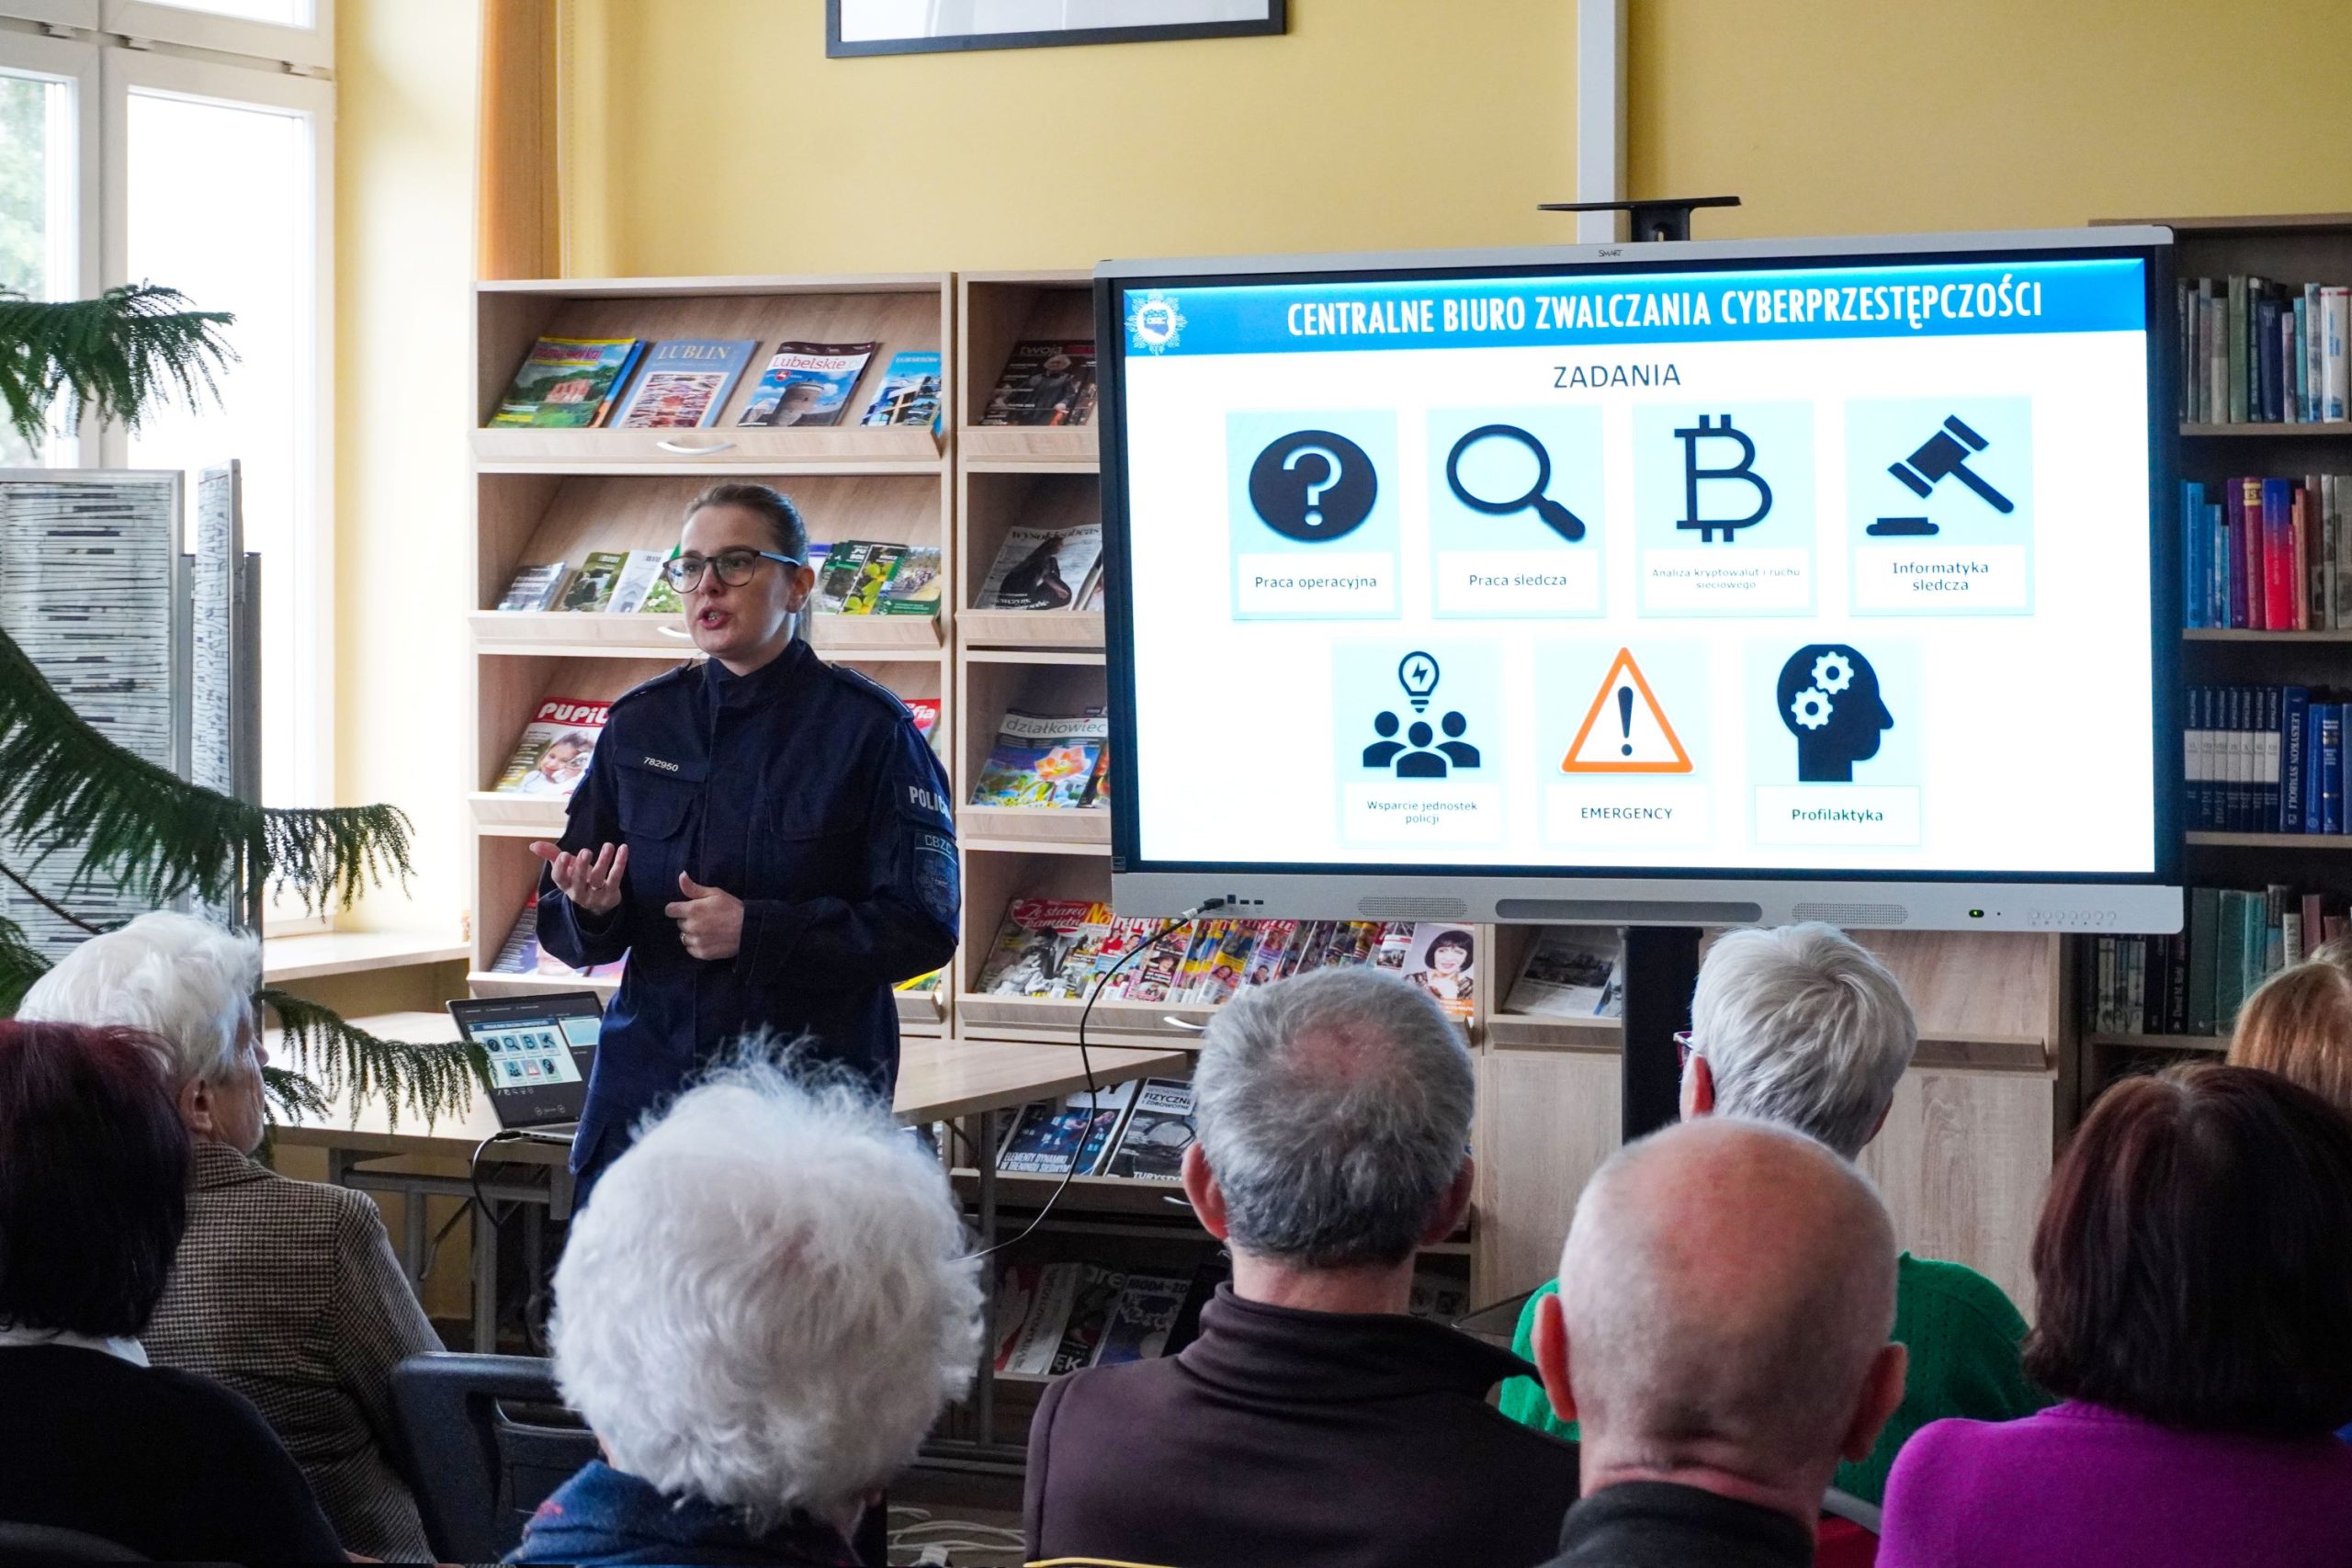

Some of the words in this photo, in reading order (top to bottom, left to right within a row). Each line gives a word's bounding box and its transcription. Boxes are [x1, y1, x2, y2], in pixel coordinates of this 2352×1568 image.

[1598, 249, 1623, 257] SMART
[1287, 299, 1434, 336] CENTRALNE
[1443, 297, 1526, 332] BIURO
[1534, 292, 1712, 330] ZWALCZANIA
[1721, 274, 2042, 330] CYBERPRZESTĘPCZOŚCI
[657, 345, 730, 360] LUBLIN
[773, 355, 846, 369] Lubelskie
[1553, 364, 1681, 389] ZADANIA
[1652, 568, 1690, 578] Analiza
[1694, 568, 1759, 579] kryptowalut
[1770, 568, 1801, 577] ruchu
[1892, 561, 1989, 575] Informatyka
[1255, 576, 1294, 589] Praca
[1298, 576, 1377, 591] operacyjna
[1469, 574, 1509, 587] Praca
[1514, 573, 1567, 587] śledcza
[1696, 581, 1757, 591] sieciowego
[1006, 718, 1106, 734] działkowiec
[643, 756, 679, 773] 782950
[1367, 800, 1419, 812] Wsparcie
[1421, 800, 1477, 813] jednostek
[1580, 807, 1673, 819] EMERGENCY
[1405, 813, 1440, 825] policji
[1792, 808, 1883, 823] Profilaktyka
[924, 834, 952, 854] CBZC
